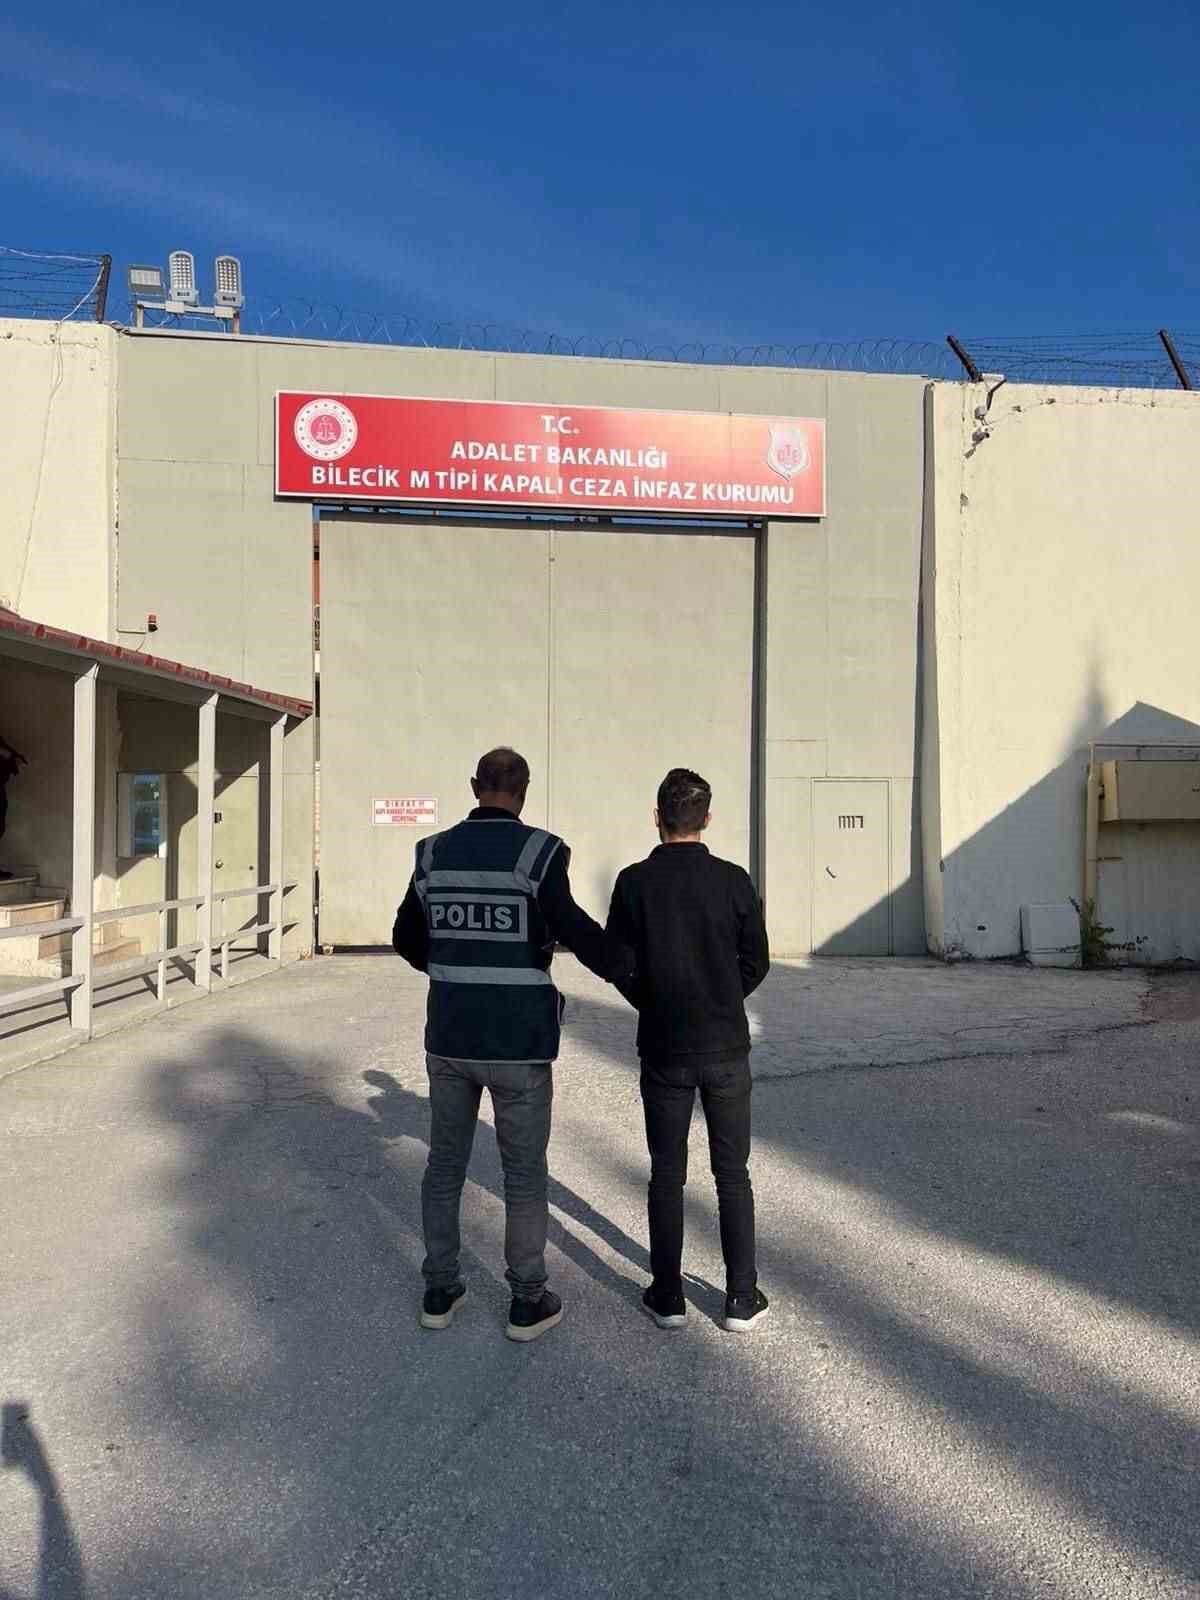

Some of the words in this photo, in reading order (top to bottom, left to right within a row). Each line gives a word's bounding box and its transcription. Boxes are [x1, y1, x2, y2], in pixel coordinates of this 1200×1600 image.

[542, 416, 579, 434] T.C.
[451, 441, 540, 462] ADALET
[547, 447, 667, 468] BAKANLIĞI
[312, 463, 400, 487] BİLECİK
[410, 471, 430, 489] M
[435, 467, 477, 491] TİPİ
[484, 473, 563, 495] KAPALI
[570, 477, 627, 497] CEZA
[634, 476, 697, 500] İNFAZ
[703, 484, 794, 504] KURUMU
